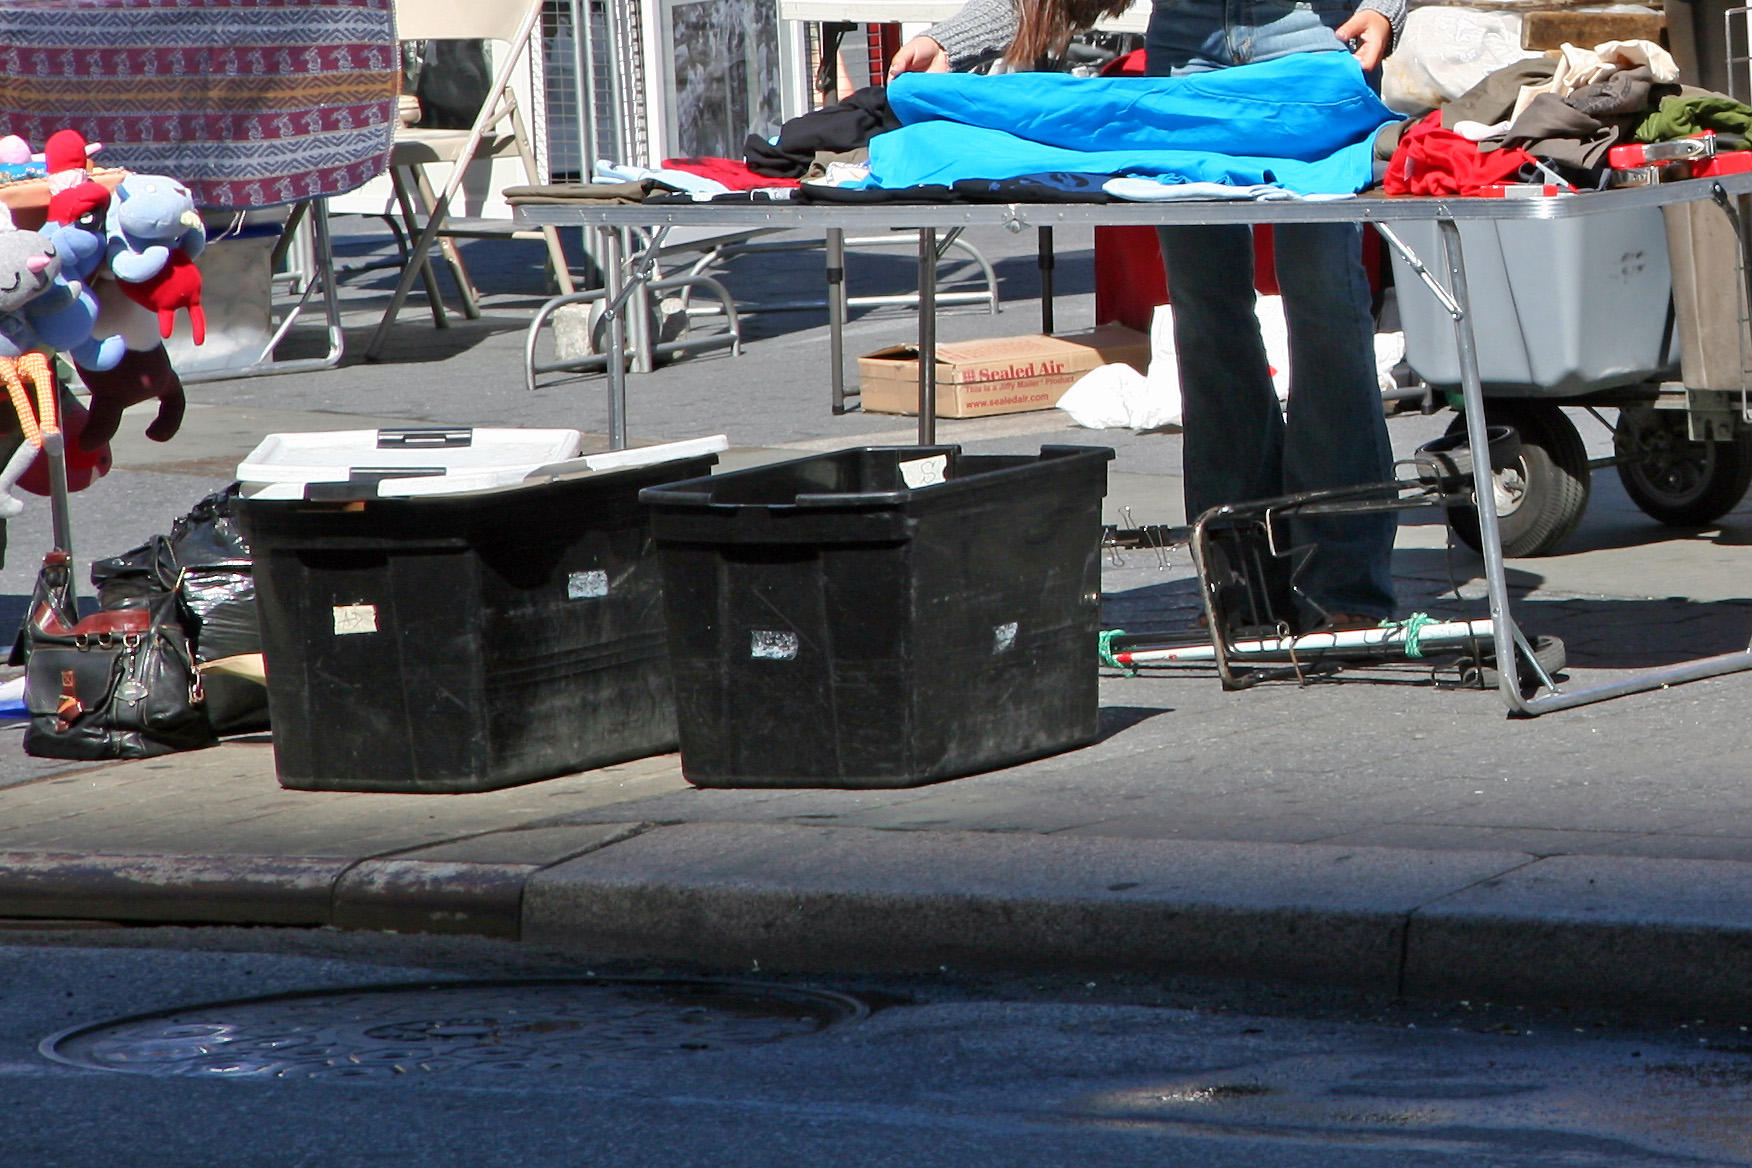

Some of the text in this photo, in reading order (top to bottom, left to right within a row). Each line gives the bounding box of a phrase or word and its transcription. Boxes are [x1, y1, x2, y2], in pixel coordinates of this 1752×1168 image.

[979, 360, 1065, 383] Sealed Air
[966, 393, 1049, 408] www.sealedair.com
